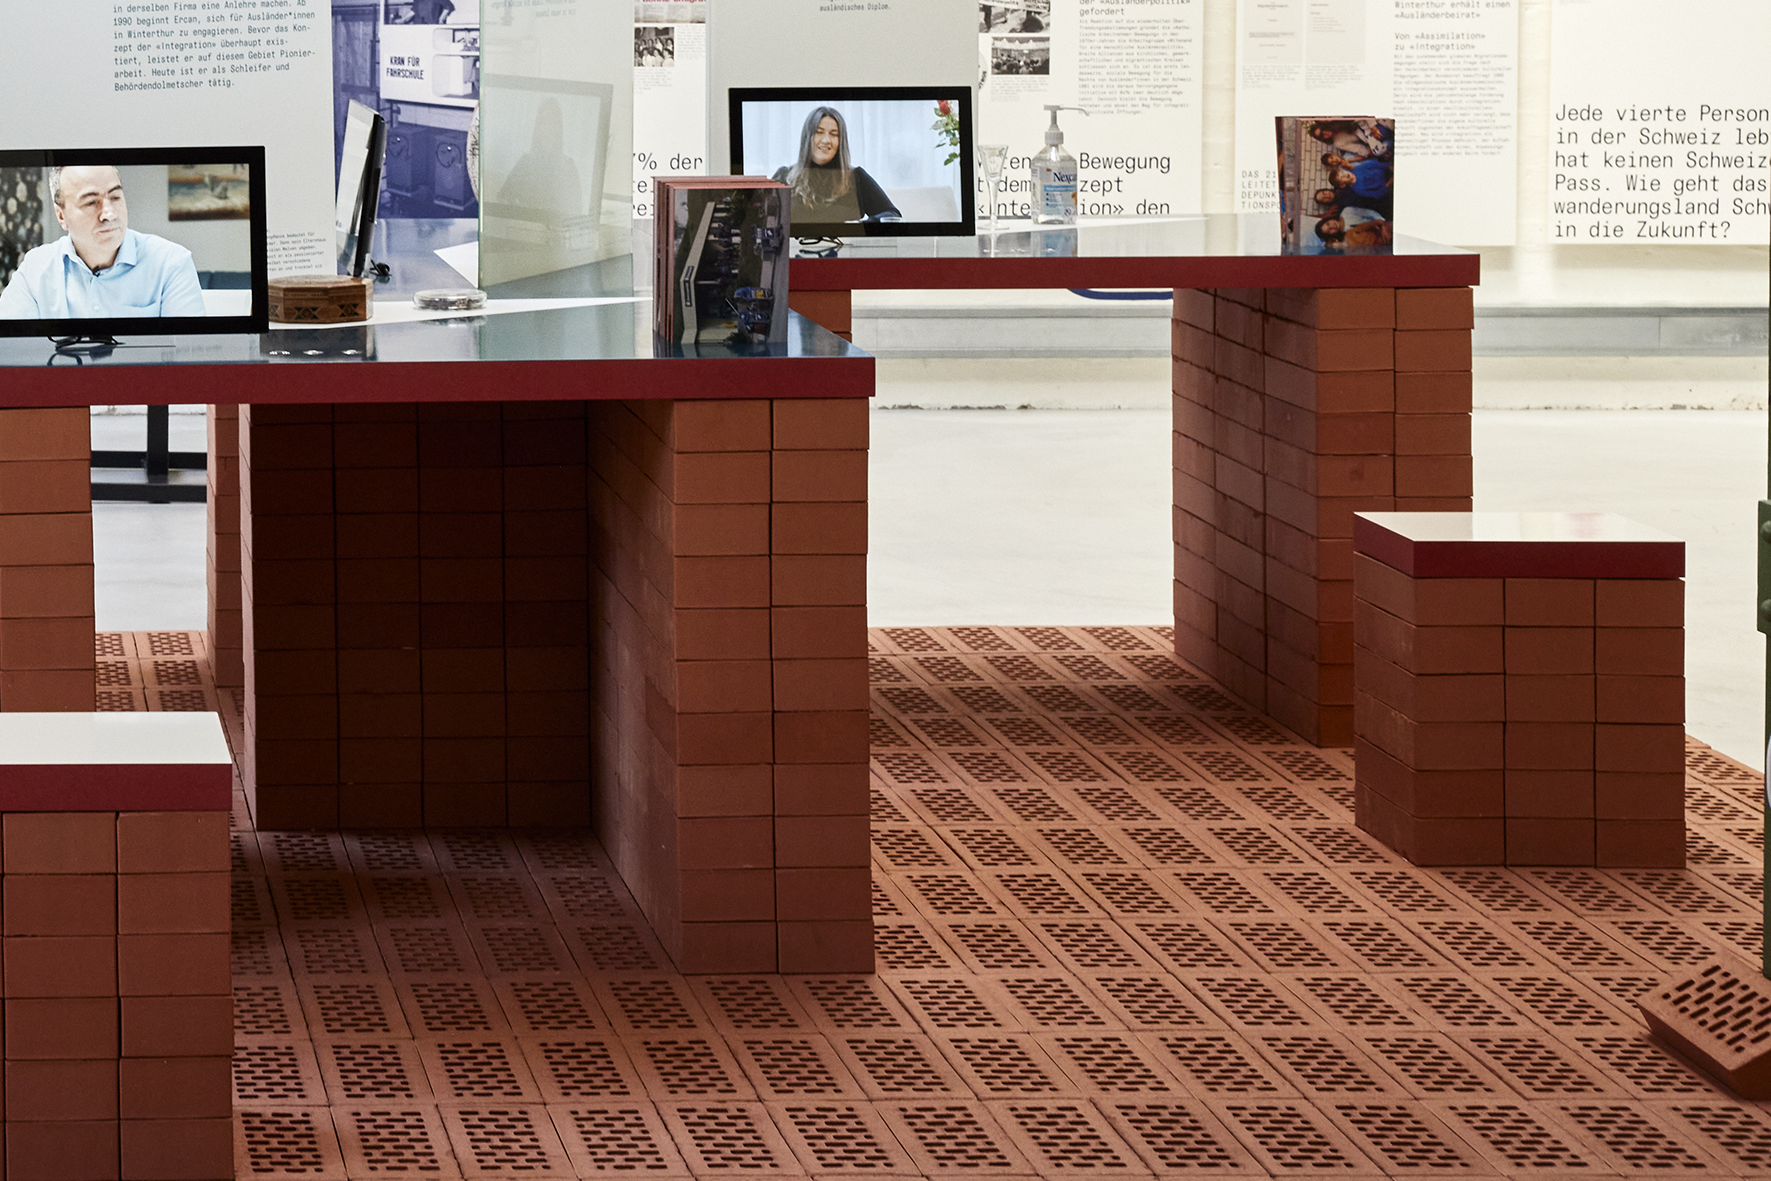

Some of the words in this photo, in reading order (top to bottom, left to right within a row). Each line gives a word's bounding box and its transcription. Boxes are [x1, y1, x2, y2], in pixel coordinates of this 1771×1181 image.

[390, 55, 405, 66] KRAN
[408, 55, 420, 67] FÜR
[386, 67, 424, 80] FAHRSCHULE
[114, 80, 203, 92] Behördendolmetscher
[208, 78, 234, 88] tätig.
[1555, 104, 1603, 121] Jede
[1616, 104, 1687, 122] vierte
[1700, 104, 1769, 122] Person
[1557, 127, 1578, 144] in
[1591, 128, 1626, 145] der
[1639, 127, 1721, 145] Schweiz
[1735, 128, 1771, 145] leb
[669, 152, 704, 170] der
[1079, 152, 1170, 174] Bewegung
[1555, 151, 1588, 168] hat
[1604, 151, 1673, 168] keinen
[1555, 174, 1610, 191] Pass.
[1626, 174, 1661, 192] Wie
[1673, 174, 1719, 196] geht
[1732, 174, 1767, 192] das
[1136, 200, 1170, 216] den
[1554, 197, 1719, 219] wanderungsland
[1556, 220, 1576, 237] in
[1589, 221, 1624, 238] die
[1636, 220, 1731, 238] Zukunft?
